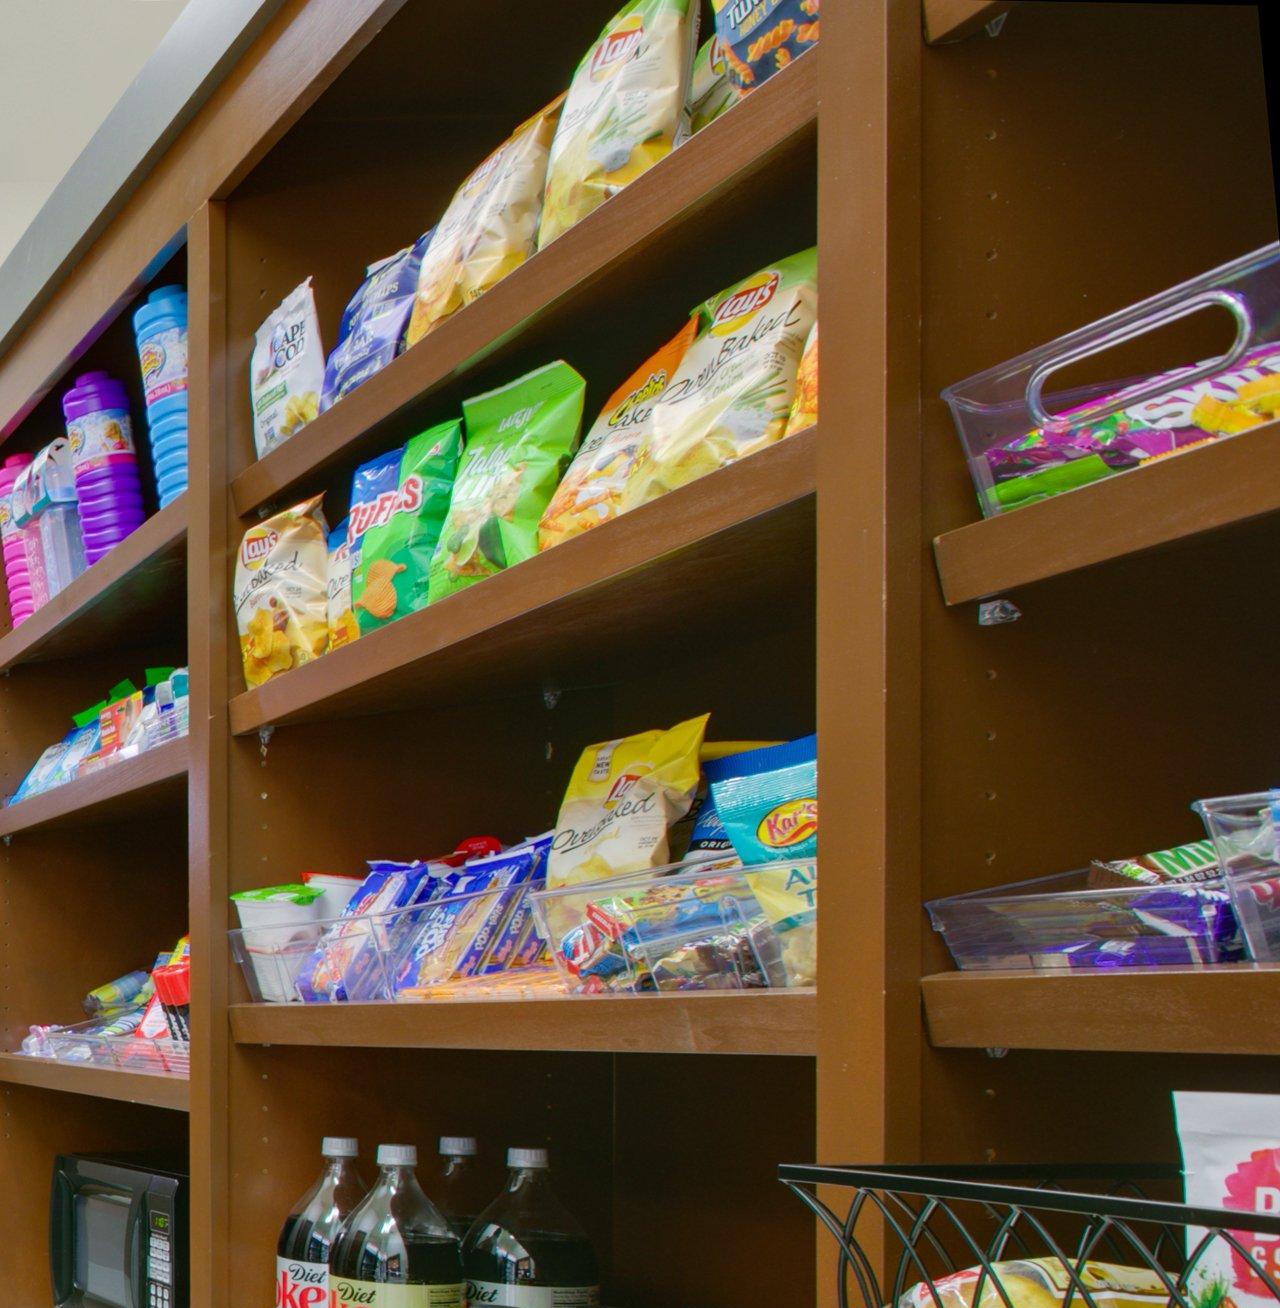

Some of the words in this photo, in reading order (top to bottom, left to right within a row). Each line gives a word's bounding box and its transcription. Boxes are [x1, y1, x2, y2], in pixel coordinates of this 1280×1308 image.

[719, 278, 779, 322] Lay's
[717, 300, 802, 366] Baked
[766, 802, 817, 841] Kar's
[289, 1264, 327, 1284] Diet
[337, 1282, 377, 1305] Diet
